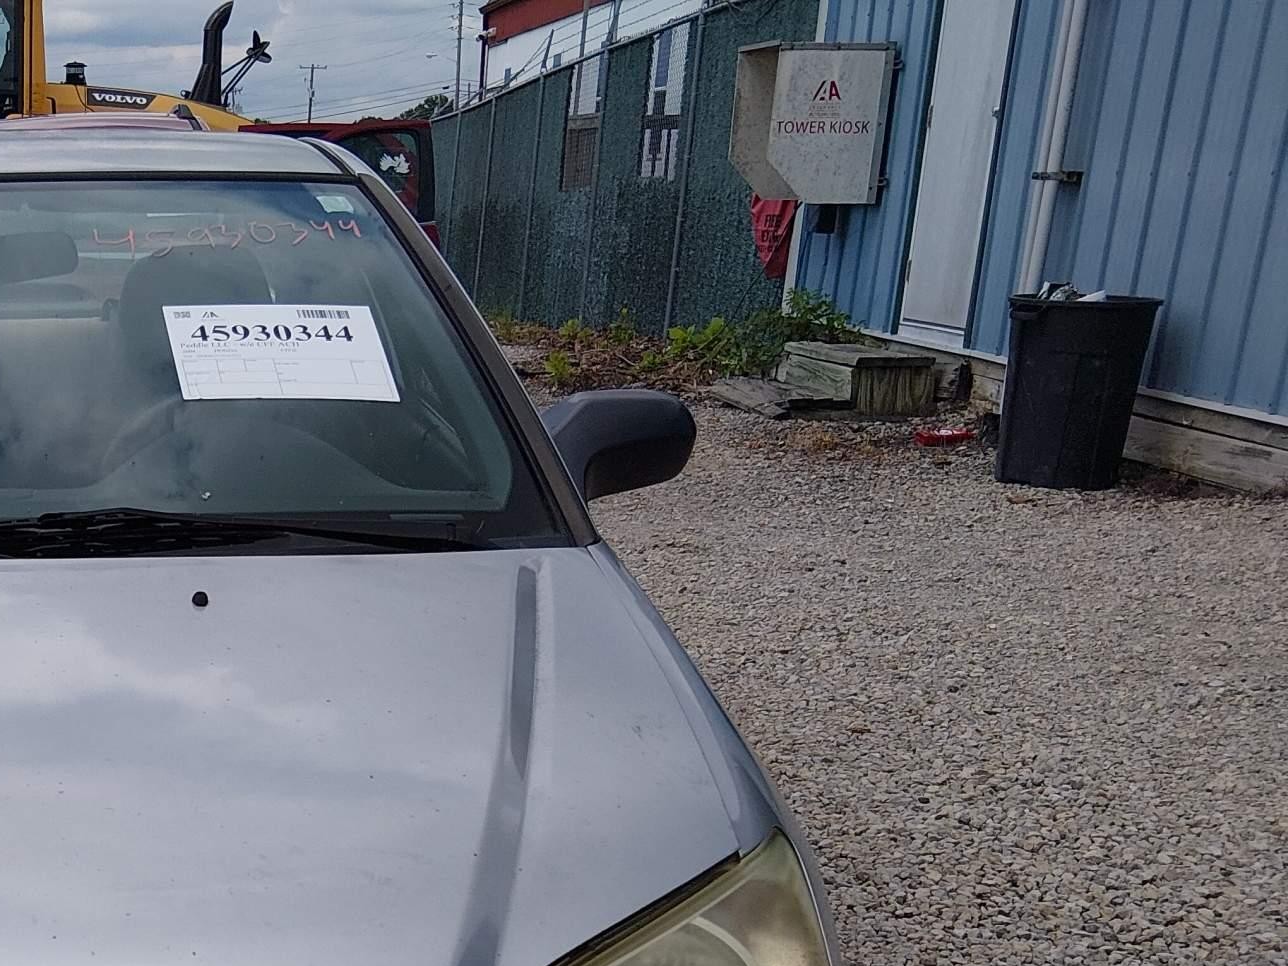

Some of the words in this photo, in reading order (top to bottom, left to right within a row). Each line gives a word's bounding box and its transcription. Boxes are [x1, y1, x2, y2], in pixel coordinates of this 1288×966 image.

[92, 93, 147, 105] VOLVO
[777, 121, 825, 134] TOWER
[829, 121, 870, 134] KIOSK
[93, 219, 362, 260] 45930344
[191, 324, 354, 342] 45930344
